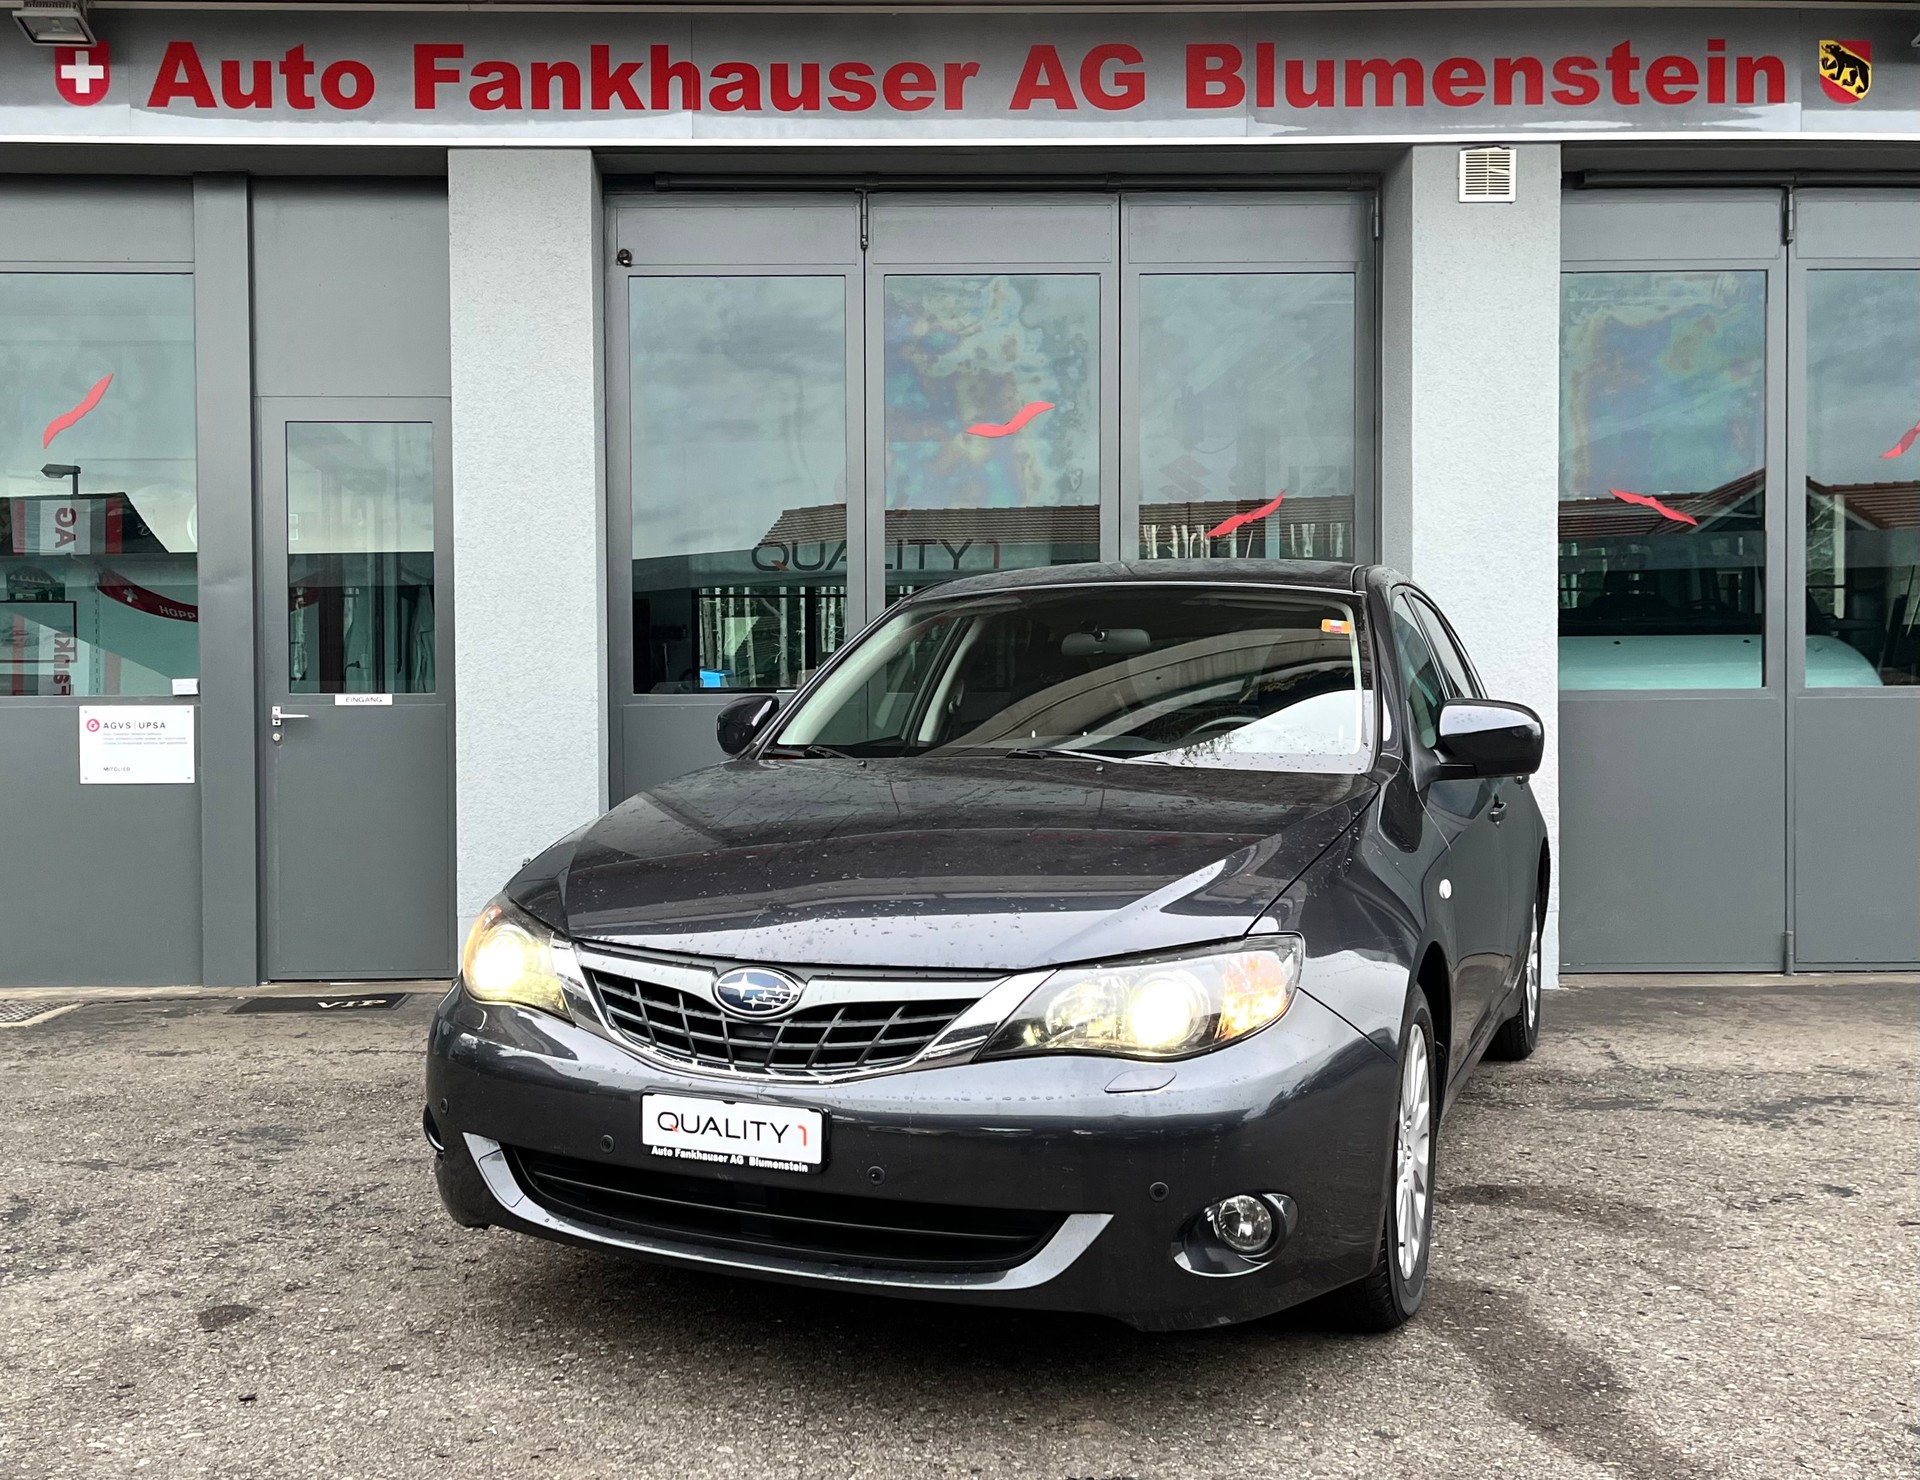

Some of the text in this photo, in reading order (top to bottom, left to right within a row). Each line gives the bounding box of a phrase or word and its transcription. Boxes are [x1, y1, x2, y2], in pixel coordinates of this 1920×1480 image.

[148, 40, 1785, 111] Auto Fankhauser AG Blumenstein
[986, 539, 1000, 570] 1
[159, 604, 196, 619] HOPP
[103, 721, 167, 730] AGVS UPSA
[317, 999, 388, 1009] VIP
[657, 1111, 808, 1147] QUALITY 1
[651, 1145, 809, 1173] Auto Fankhauser AG Blumenstein
